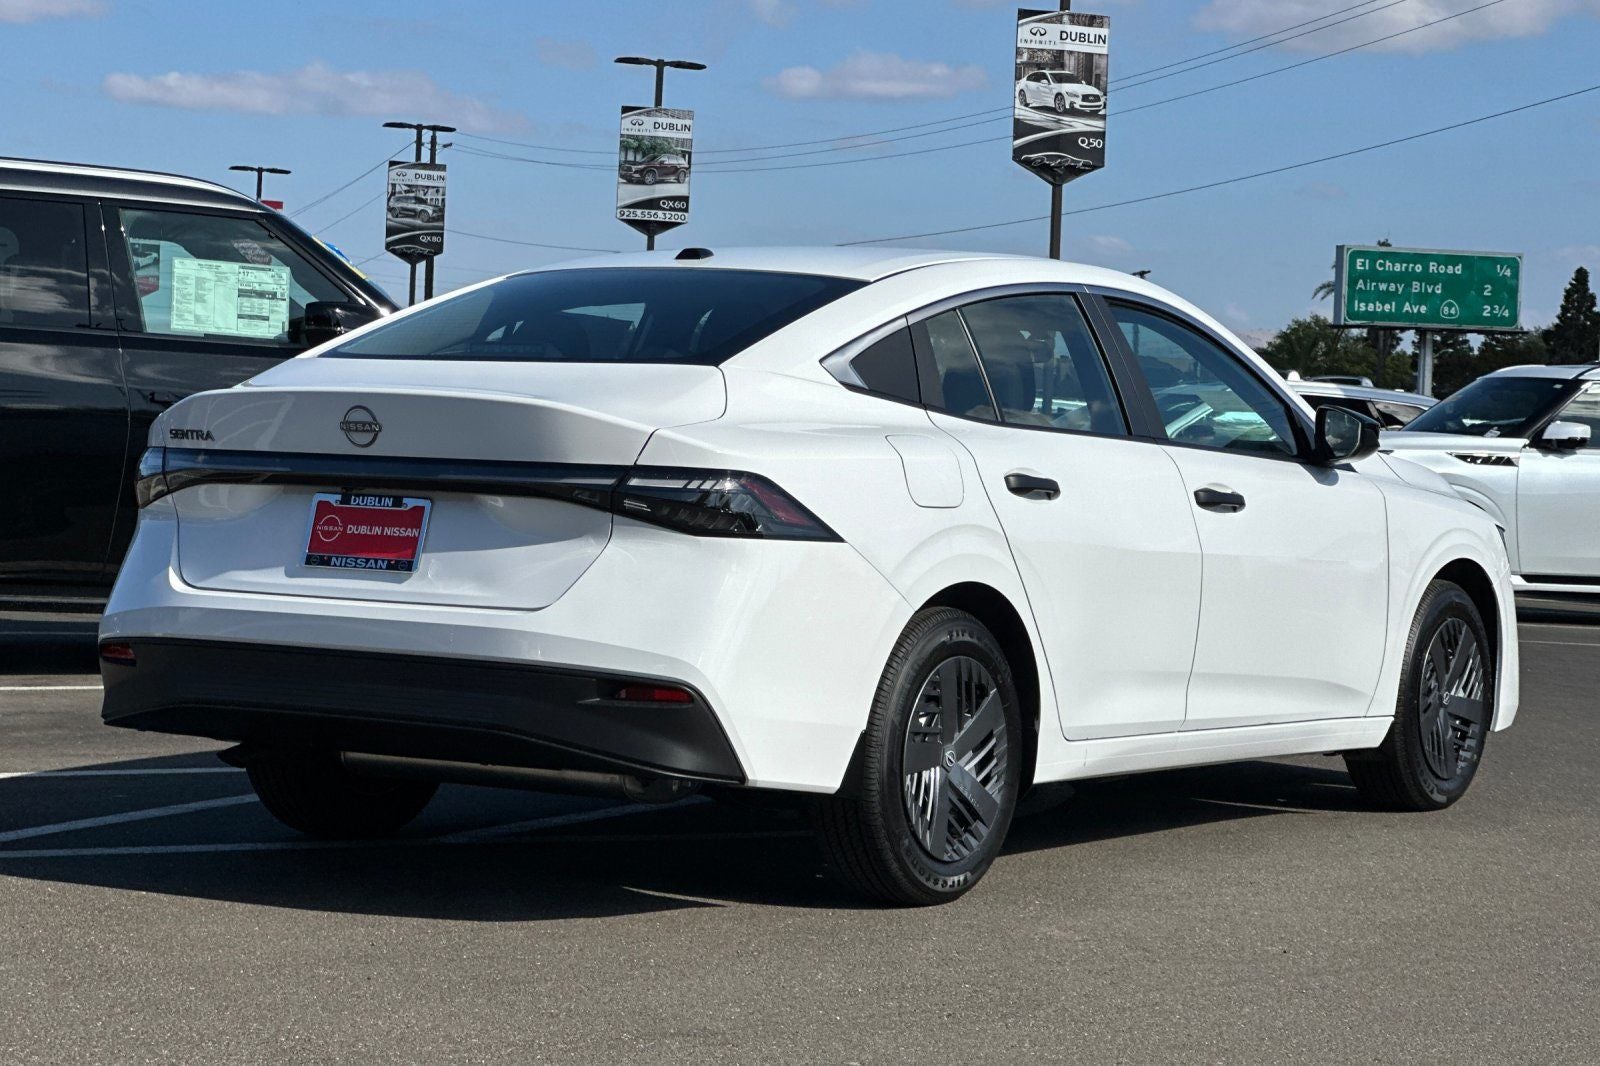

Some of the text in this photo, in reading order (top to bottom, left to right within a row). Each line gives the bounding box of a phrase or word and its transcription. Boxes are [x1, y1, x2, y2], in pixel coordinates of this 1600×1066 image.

[1059, 30, 1107, 45] DUBLIN
[653, 121, 691, 131] DUBLIN
[1078, 136, 1103, 149] Q50
[414, 172, 445, 182] DUBLIN
[659, 199, 687, 209] QX60
[619, 209, 687, 221] 925.556.3200
[419, 234, 442, 243] QX80
[1355, 258, 1369, 270] El
[1375, 260, 1423, 273] Charro
[1429, 262, 1462, 275] Road
[1356, 279, 1492, 296] Airway Blvd 2
[1354, 300, 1395, 313] Isabel
[1402, 302, 1427, 314] Ave
[1442, 306, 1456, 315] 84
[1482, 305, 1491, 317] 2
[340, 422, 380, 431] NISSAN
[169, 429, 215, 441] SENTRA
[350, 495, 393, 507] DUBLIN
[346, 524, 420, 538] DUBLIN NISSAN
[330, 556, 388, 570] NISSAN
